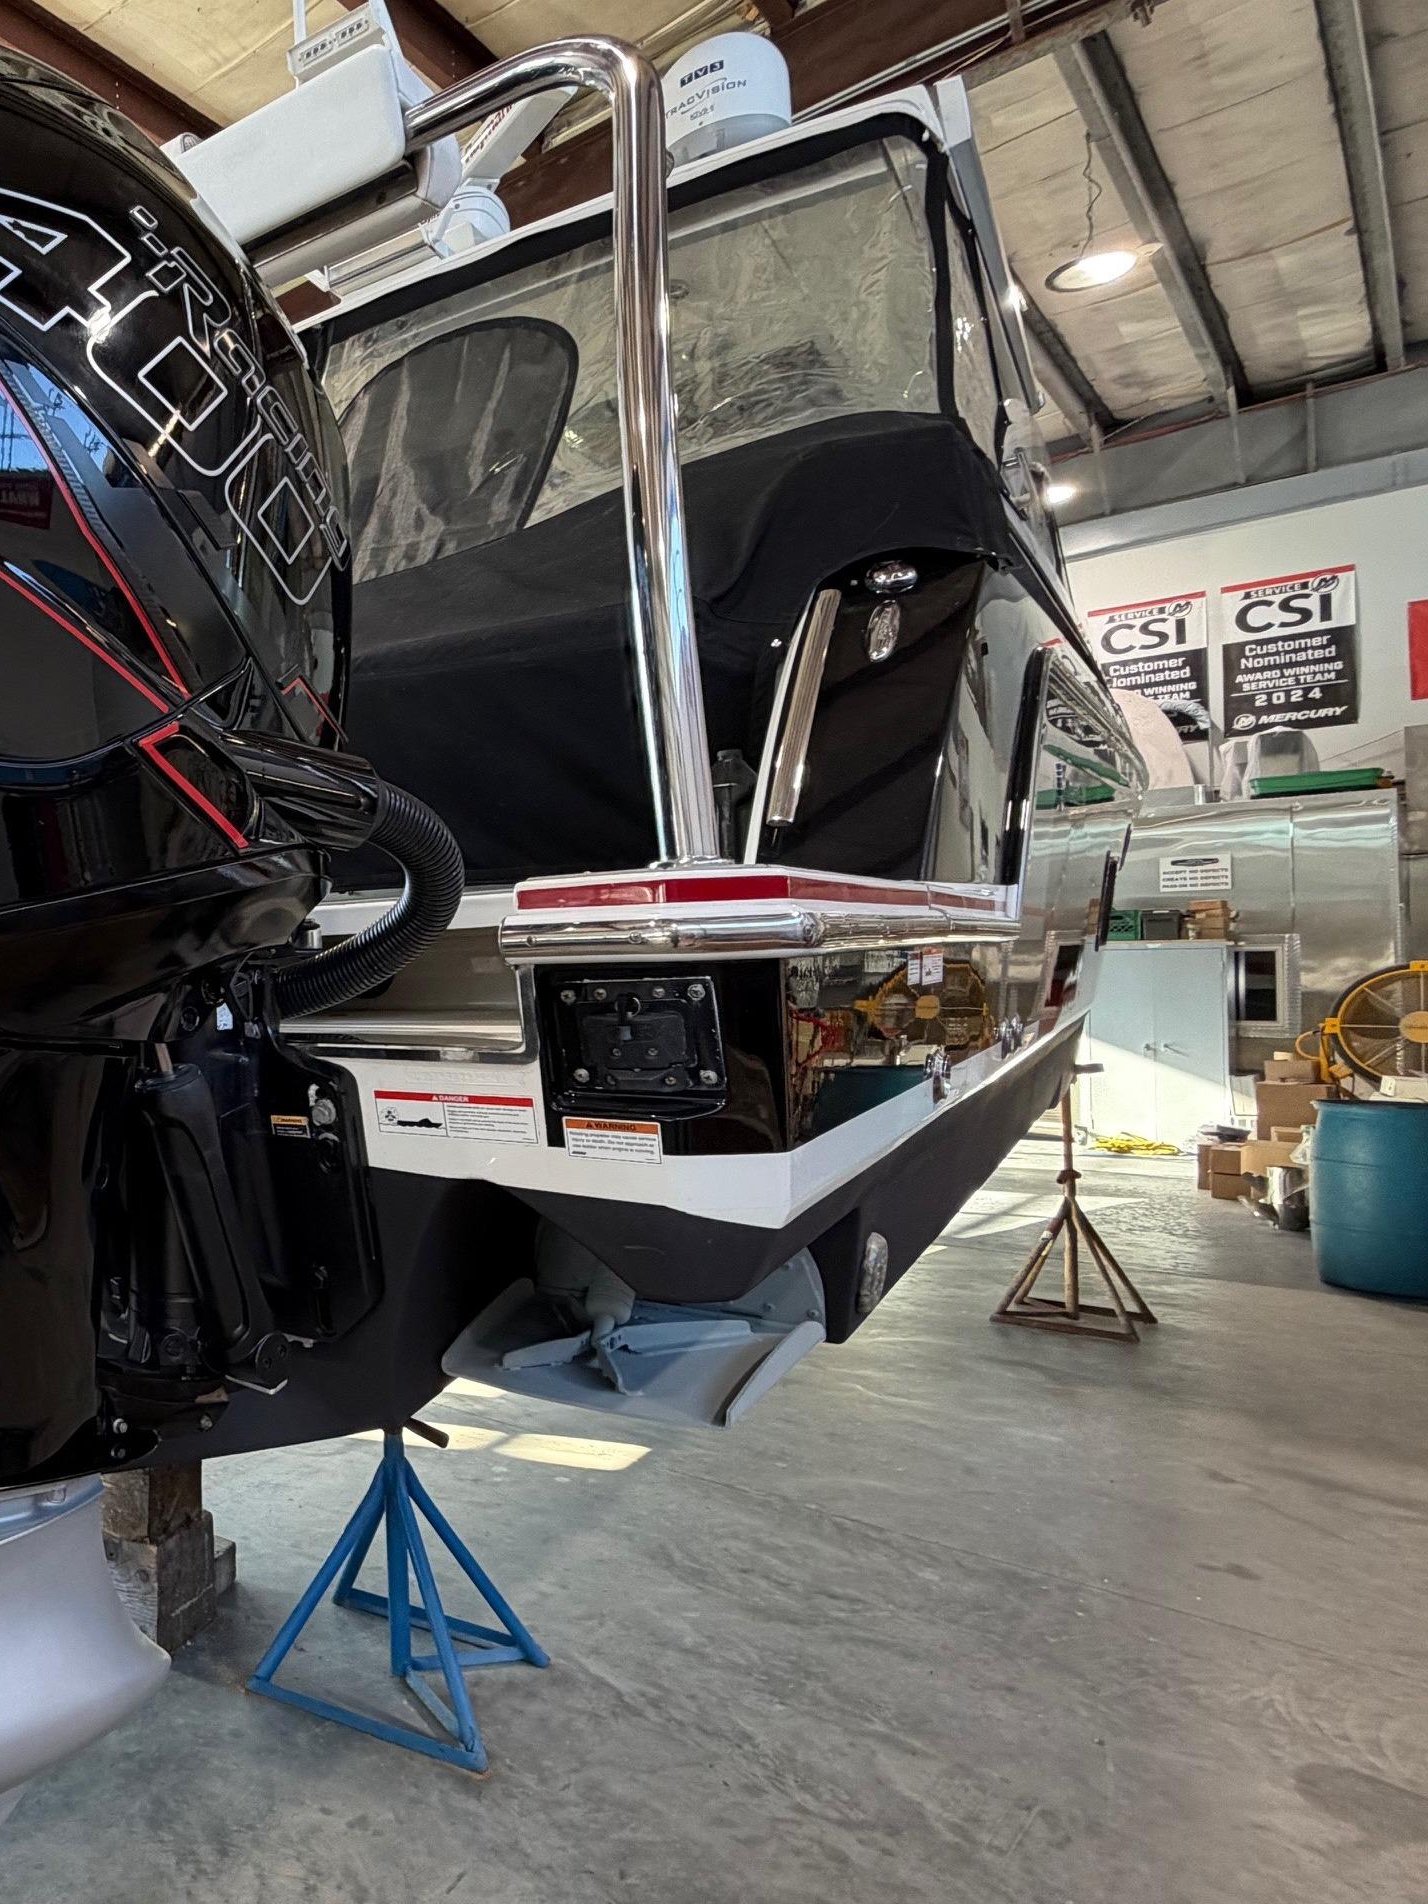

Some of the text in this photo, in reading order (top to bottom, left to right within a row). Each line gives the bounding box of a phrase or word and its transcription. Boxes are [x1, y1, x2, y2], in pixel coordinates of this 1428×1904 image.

[1250, 583, 1302, 599] SERVICE
[1113, 607, 1159, 623] SERVICE
[1235, 593, 1332, 633] CSI
[1100, 617, 1187, 655] CSI
[1245, 634, 1332, 657] Customer
[1109, 657, 1186, 677] Customer
[1240, 645, 1336, 670] Nominated
[1235, 661, 1344, 684] AWARD WINNING
[1242, 671, 1336, 691] SERVICE TEAM
[1143, 681, 1198, 696] WINNING
[1158, 691, 1191, 701] TEAM
[1258, 705, 1349, 725] MERCURY
[438, 1094, 469, 1103] DANGER
[594, 1121, 637, 1131] WARNING
